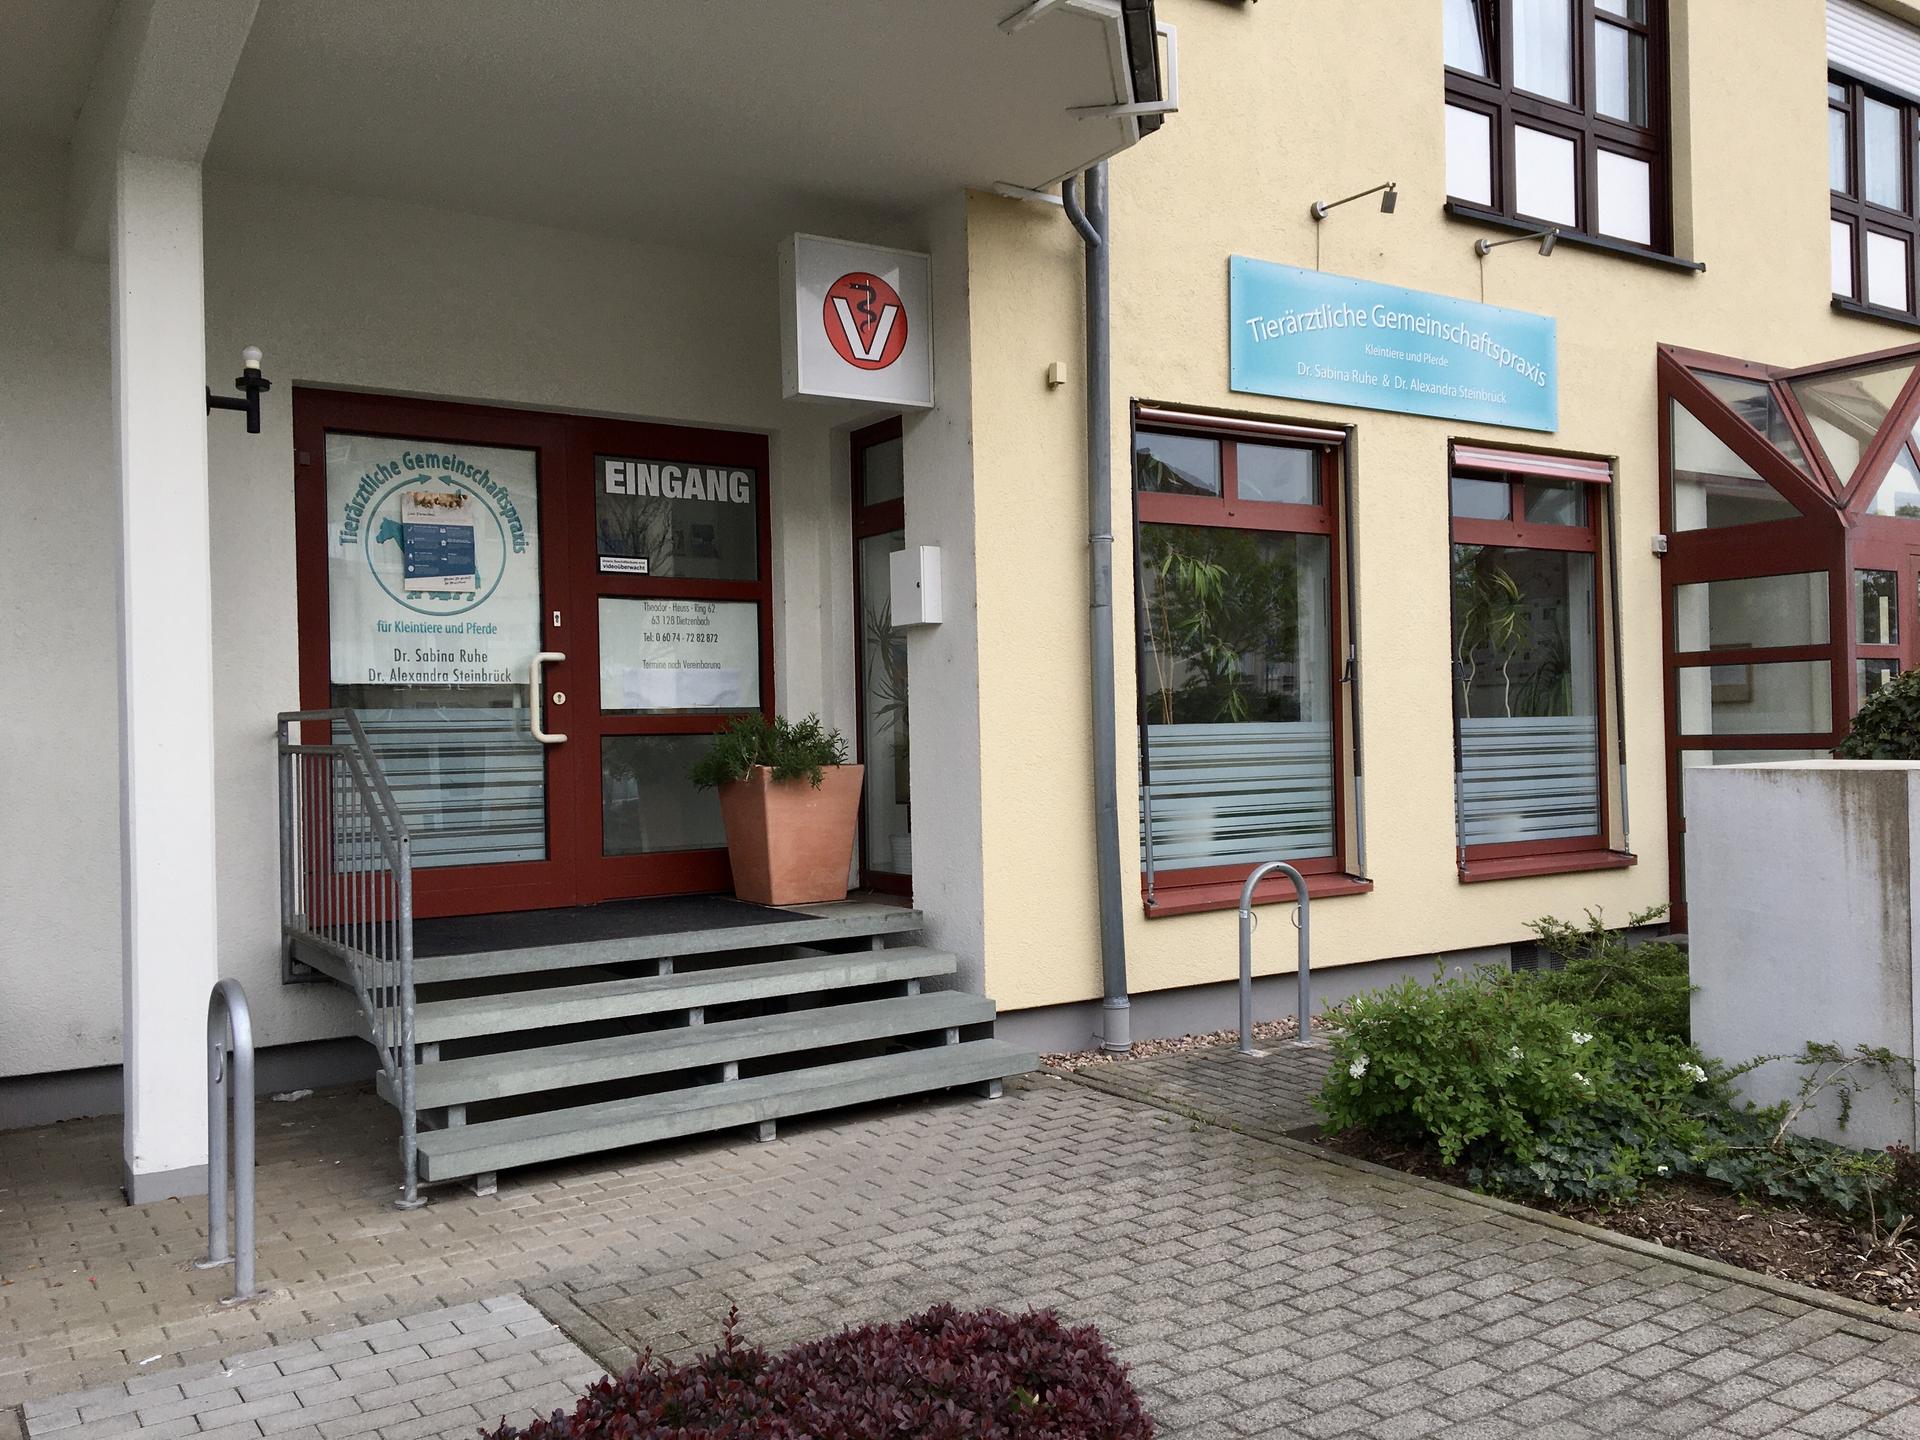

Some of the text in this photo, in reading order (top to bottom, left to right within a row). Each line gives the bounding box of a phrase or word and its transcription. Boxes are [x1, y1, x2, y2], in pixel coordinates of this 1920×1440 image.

[1246, 302, 1547, 387] Tierärztliche Gemeinschaftspraxis
[1365, 343, 1449, 367] Kleintiere und Pferde
[1297, 361, 1507, 403] Dr. Sabina Ruhe & Dr. Alexandra Steinbrück
[605, 460, 750, 504] EINGANG
[339, 451, 529, 554] Tierärztliche Gemeinschaftspraxis
[603, 563, 646, 571] videoüberwacht
[643, 602, 668, 612] Theodor
[672, 603, 690, 613] Heuss
[694, 603, 707, 615] Ring
[377, 620, 497, 635] für Kleintiere und Pferde
[651, 615, 711, 626] 63 128 Dietzenbach
[656, 633, 660, 641] 0
[662, 633, 671, 642] 60
[672, 633, 681, 642] 74
[686, 633, 695, 642] 72
[696, 633, 705, 642] 82
[706, 633, 718, 643] 872
[394, 648, 488, 663] Dr. Sabina Ruhe
[642, 659, 721, 671] Termine nach Vereinbarung
[368, 668, 512, 682] Dr. Alexandra Steinbrück
